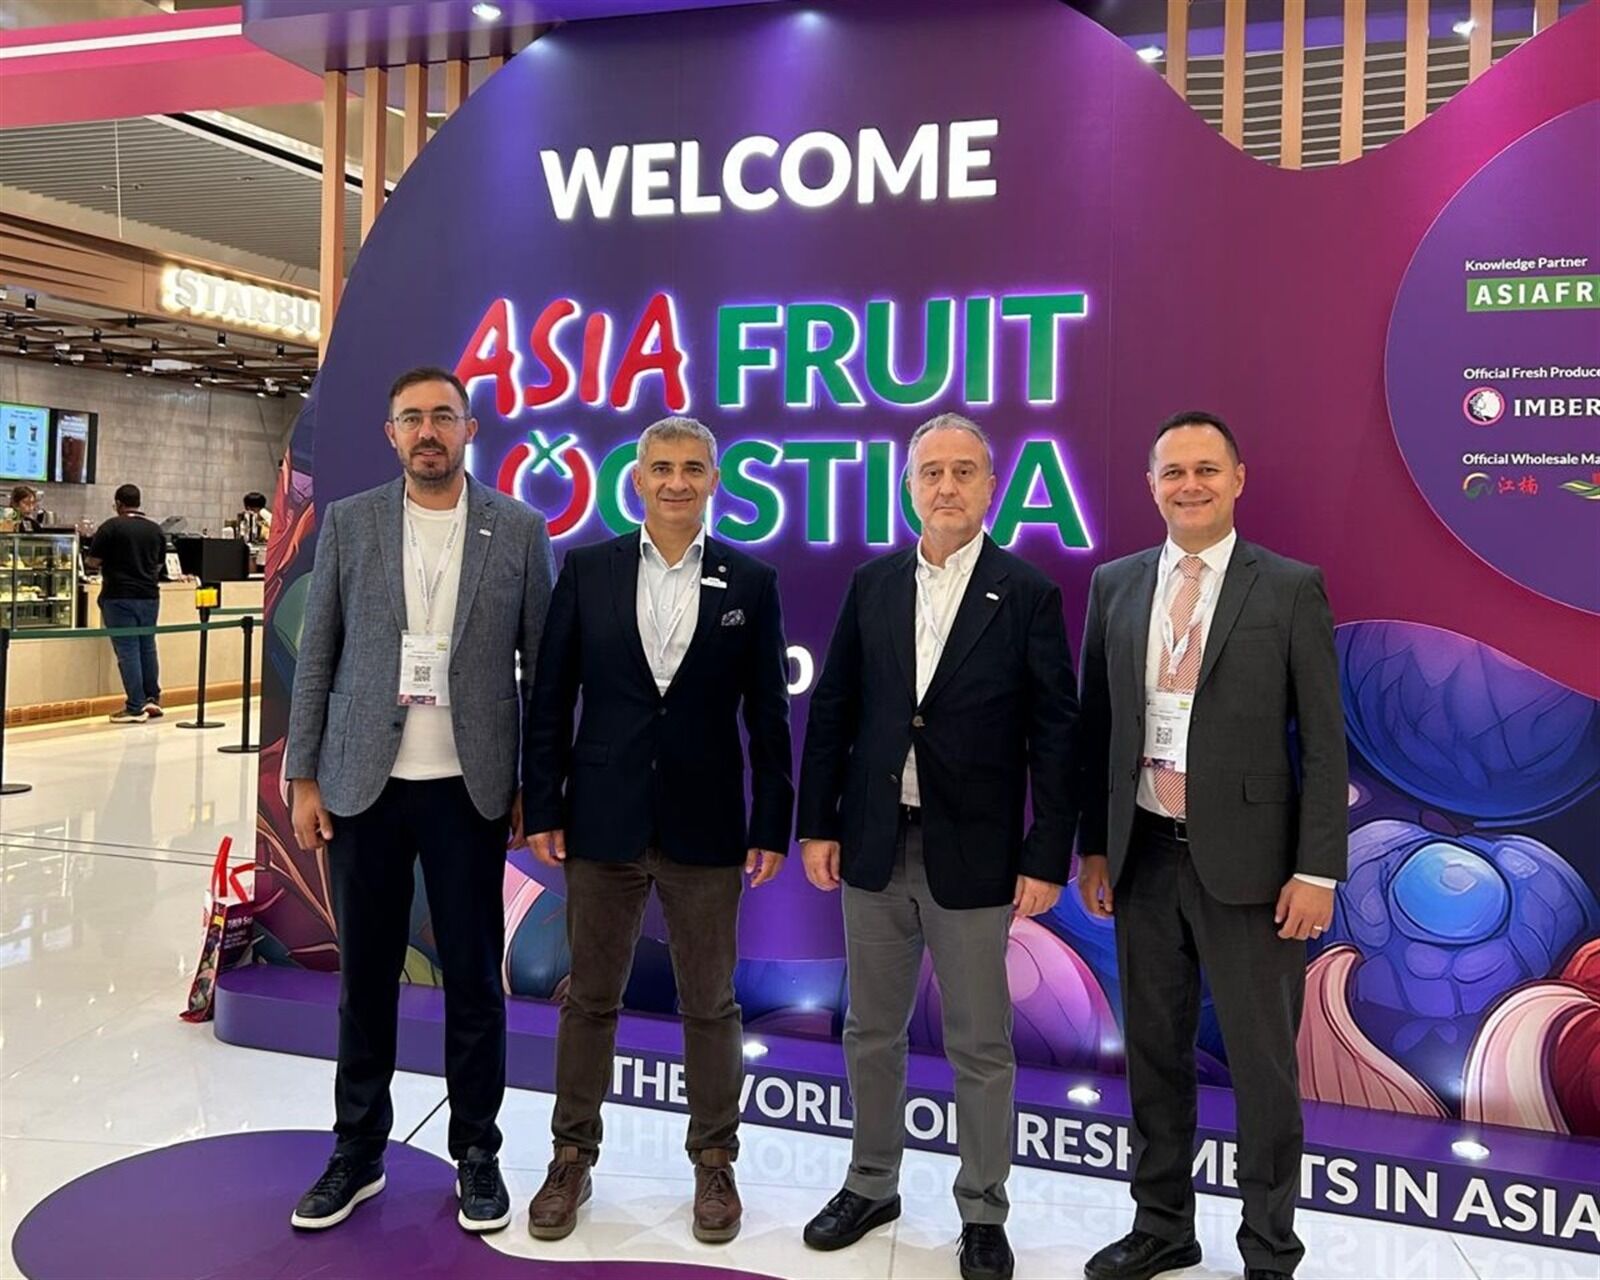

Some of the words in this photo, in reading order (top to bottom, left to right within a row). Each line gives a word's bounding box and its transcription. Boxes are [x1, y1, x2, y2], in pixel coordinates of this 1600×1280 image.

[540, 119, 999, 220] WELCOME
[1465, 258, 1536, 272] Knowledge
[1538, 257, 1588, 269] Partner
[1474, 281, 1594, 305] ASIAFR
[455, 292, 689, 419] ASIA
[716, 293, 1089, 409] FRUIT
[1463, 367, 1510, 379] Official
[1512, 367, 1548, 379] Fresh
[1514, 398, 1600, 417] IMBER
[1462, 453, 1509, 465] Official
[1511, 453, 1580, 465] Wholesale
[612, 1055, 689, 1105] THE
[1375, 1164, 1438, 1218] IN
[1453, 1177, 1600, 1242] ASIA
